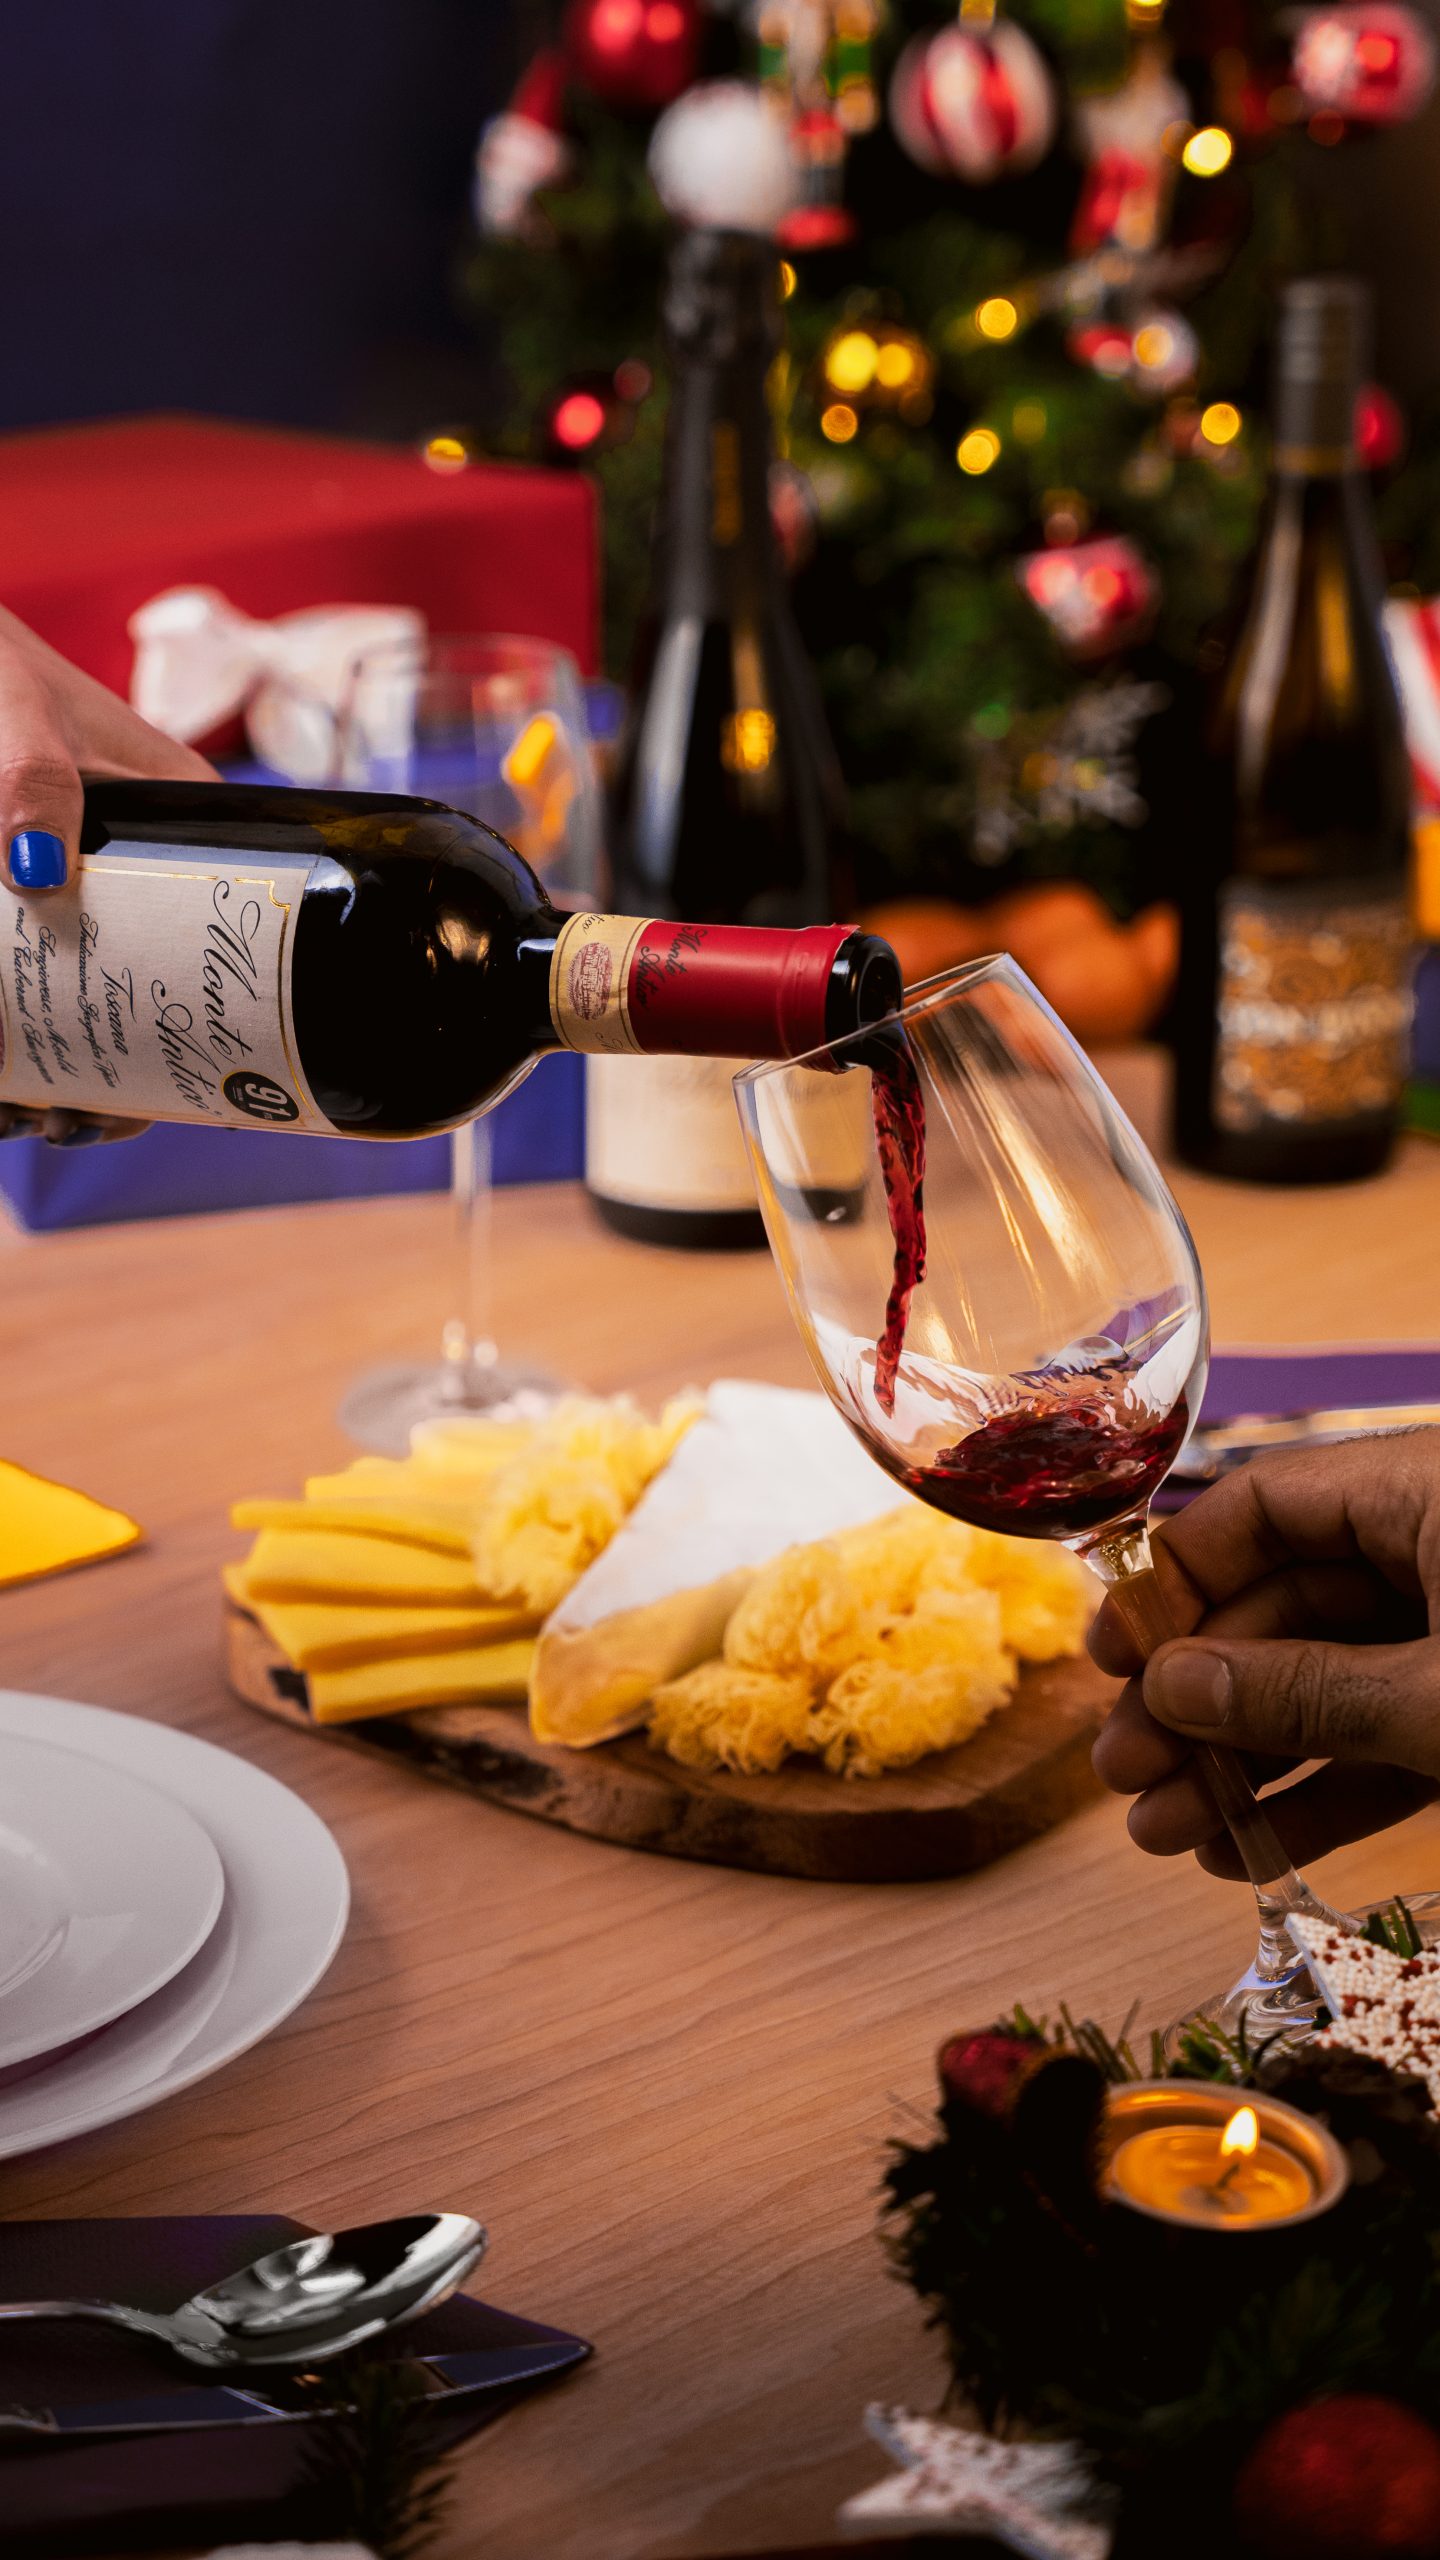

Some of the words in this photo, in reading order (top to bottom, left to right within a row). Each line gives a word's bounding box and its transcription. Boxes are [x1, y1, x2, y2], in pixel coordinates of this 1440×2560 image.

[15, 907, 32, 944] and
[79, 913, 98, 995] Indicazione
[665, 926, 708, 976] Monte
[13, 946, 35, 1021] Cabernet
[32, 927, 57, 1013] Sangiovese,
[203, 881, 262, 1064] Monte
[636, 946, 664, 1010] Antico
[100, 966, 137, 1055] Toscana
[150, 980, 222, 1113] Antico
[245, 1083, 291, 1116] 91
